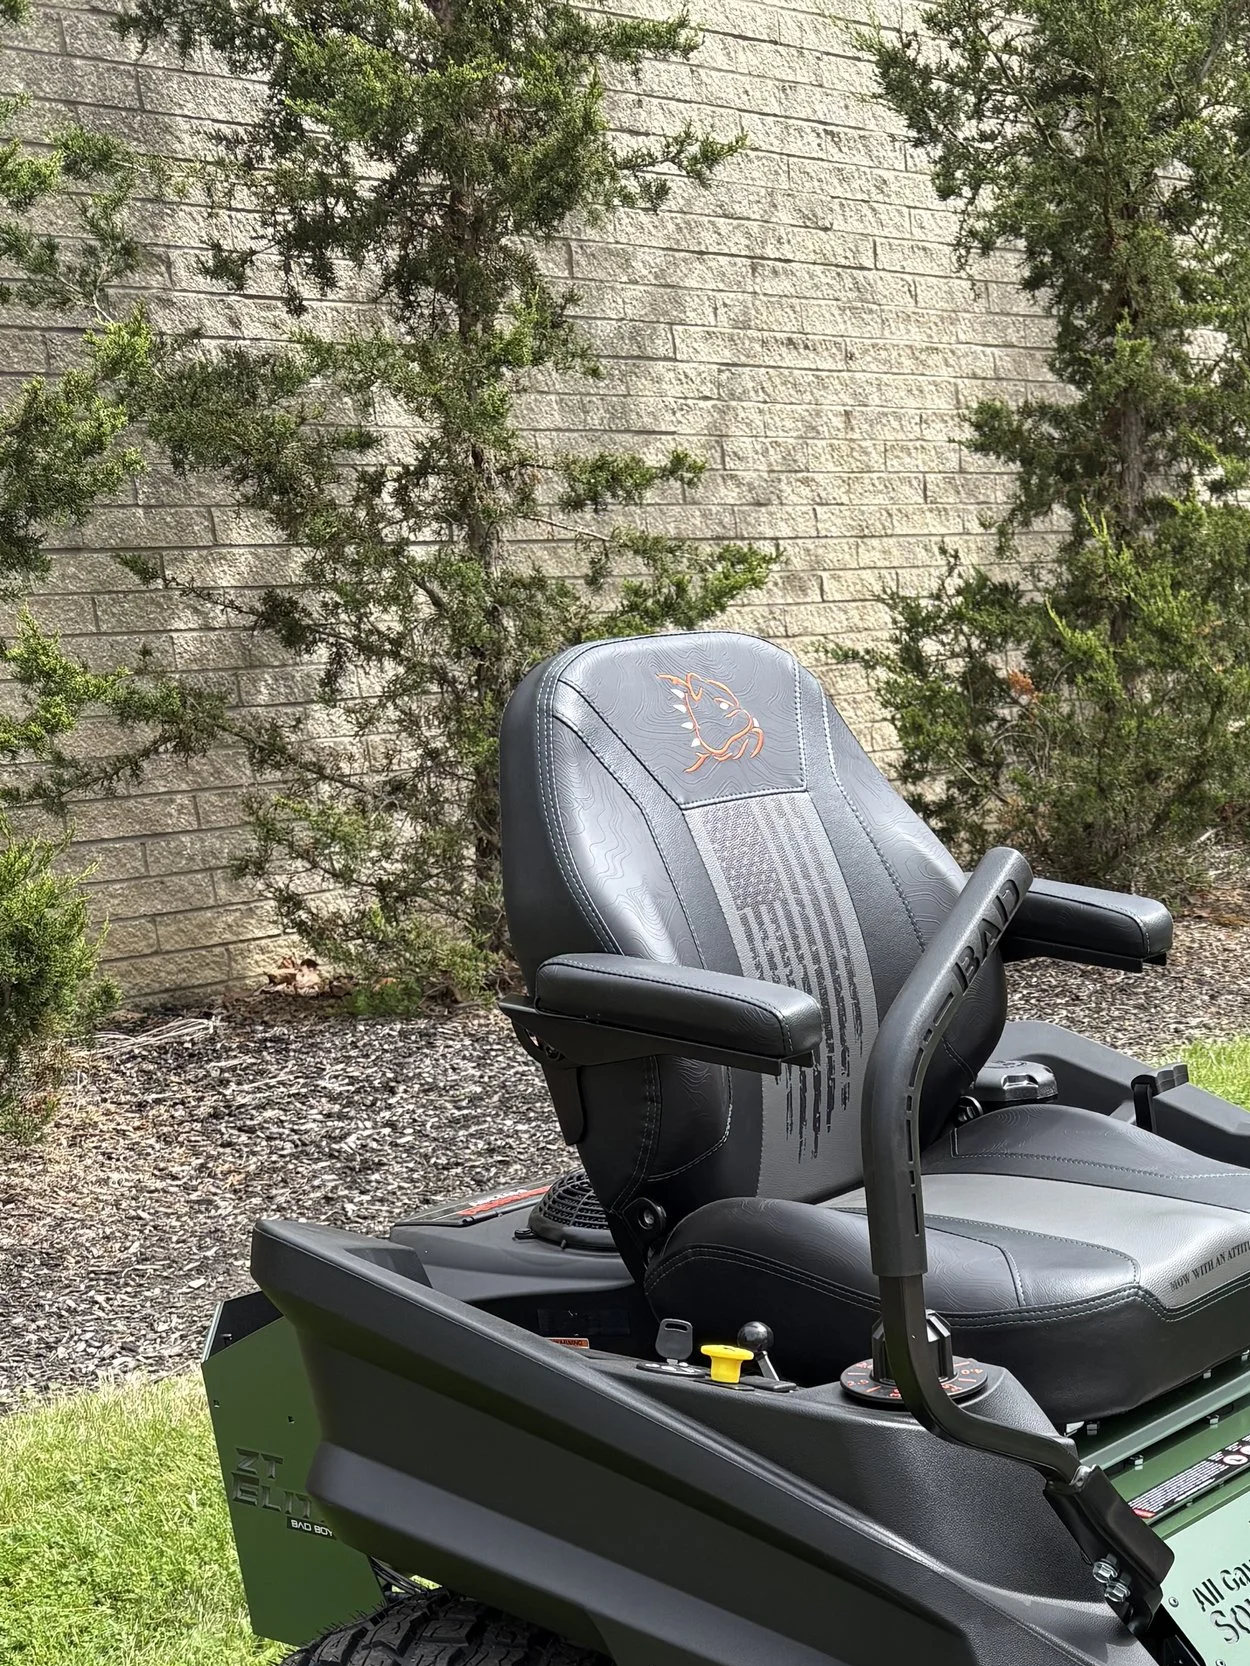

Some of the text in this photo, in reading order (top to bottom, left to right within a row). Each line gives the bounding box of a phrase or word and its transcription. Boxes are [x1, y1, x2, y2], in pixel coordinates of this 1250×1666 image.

[952, 879, 1020, 994] BAD
[1170, 1273, 1191, 1292] MOW
[1192, 1260, 1215, 1280] WITH
[1215, 1253, 1226, 1267] AN
[236, 1447, 283, 1480] ZT
[231, 1471, 316, 1520] ELIT
[290, 1519, 333, 1537] BAD BOY
